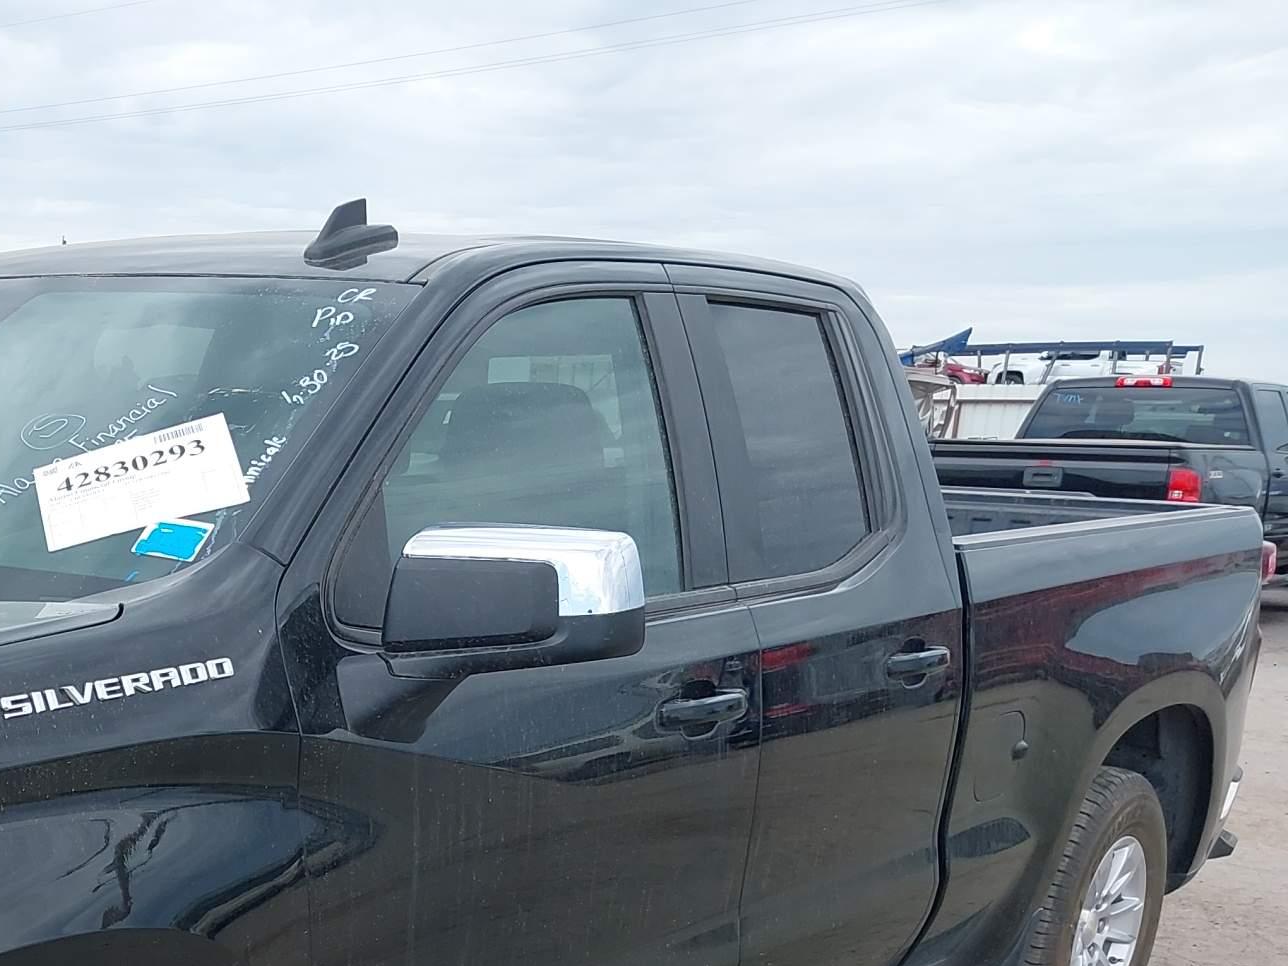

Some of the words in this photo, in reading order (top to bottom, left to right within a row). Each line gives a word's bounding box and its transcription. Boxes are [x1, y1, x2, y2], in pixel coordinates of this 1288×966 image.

[68, 384, 178, 453] Financial
[56, 438, 205, 492] 42830293
[0, 657, 235, 719] SILVERADO
